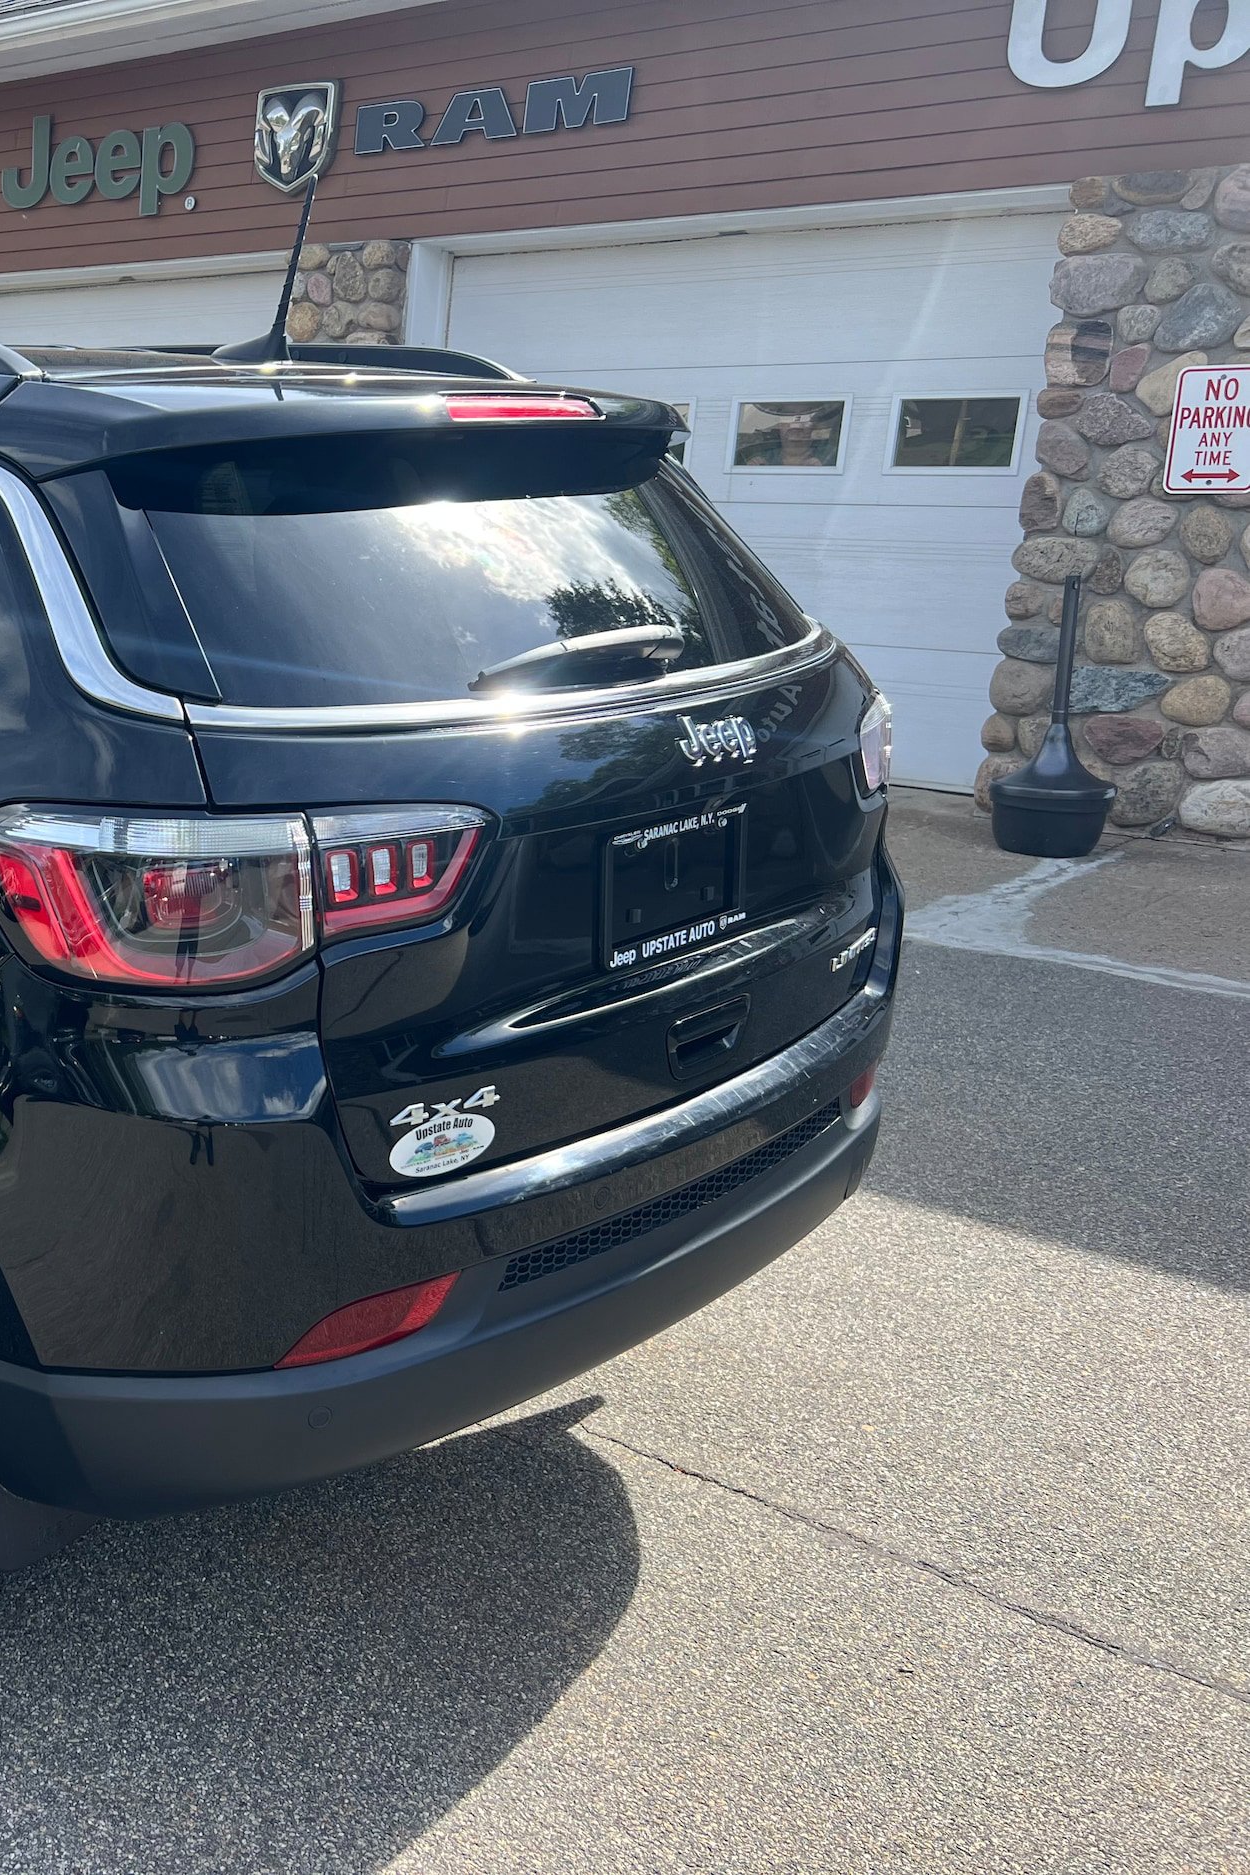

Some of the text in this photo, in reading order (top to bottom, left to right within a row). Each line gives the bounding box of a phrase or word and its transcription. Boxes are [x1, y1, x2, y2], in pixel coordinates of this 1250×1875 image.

[354, 66, 634, 156] RAM
[1, 115, 195, 217] Jeep
[1205, 378, 1239, 401] NO
[1198, 432, 1233, 447] ANY
[1195, 451, 1232, 466] TIME
[675, 714, 757, 766] Jeep
[643, 821, 679, 842] SARANAC
[679, 816, 700, 833] LAKE,
[727, 912, 746, 924] RAM
[642, 920, 715, 958] UPSTATE AUTO
[610, 949, 636, 968] Jeep
[415, 1117, 474, 1141] Upstate Auto
[415, 1162, 441, 1174] Saranac
[460, 1153, 470, 1161] NY
